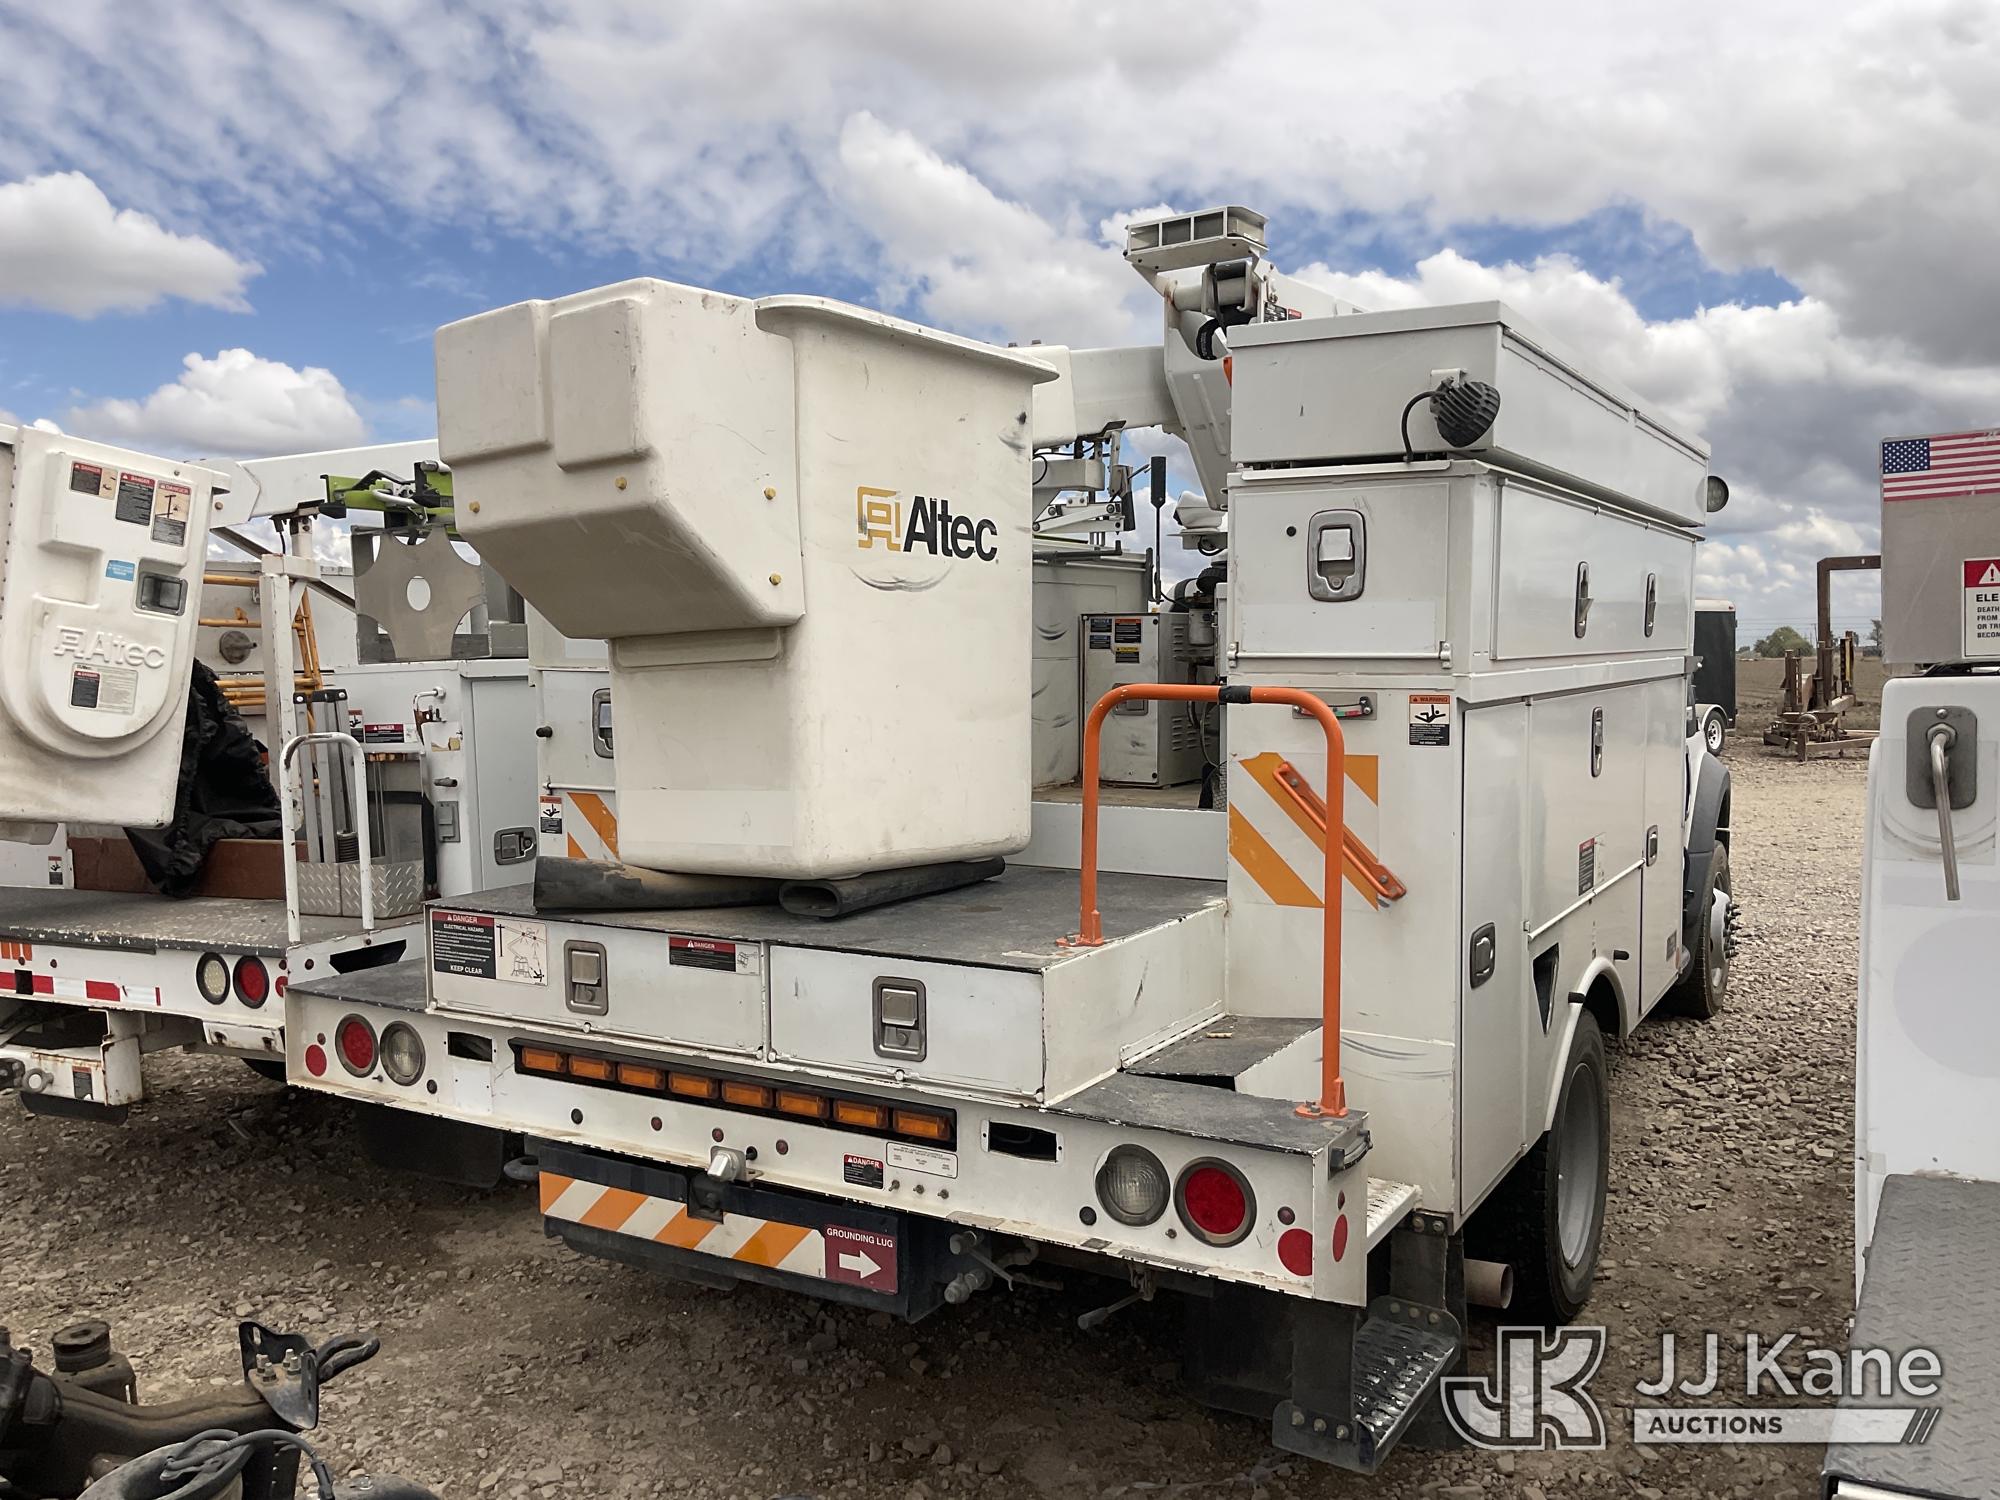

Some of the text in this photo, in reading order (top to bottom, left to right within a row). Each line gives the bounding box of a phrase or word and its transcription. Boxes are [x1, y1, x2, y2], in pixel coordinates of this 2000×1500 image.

[902, 495, 998, 562] Altec
[452, 914, 478, 924] DANGER
[693, 941, 715, 949] DANGER
[450, 964, 483, 975] KEEP CLEAR
[826, 1227, 893, 1248] GROUNDING LUG
